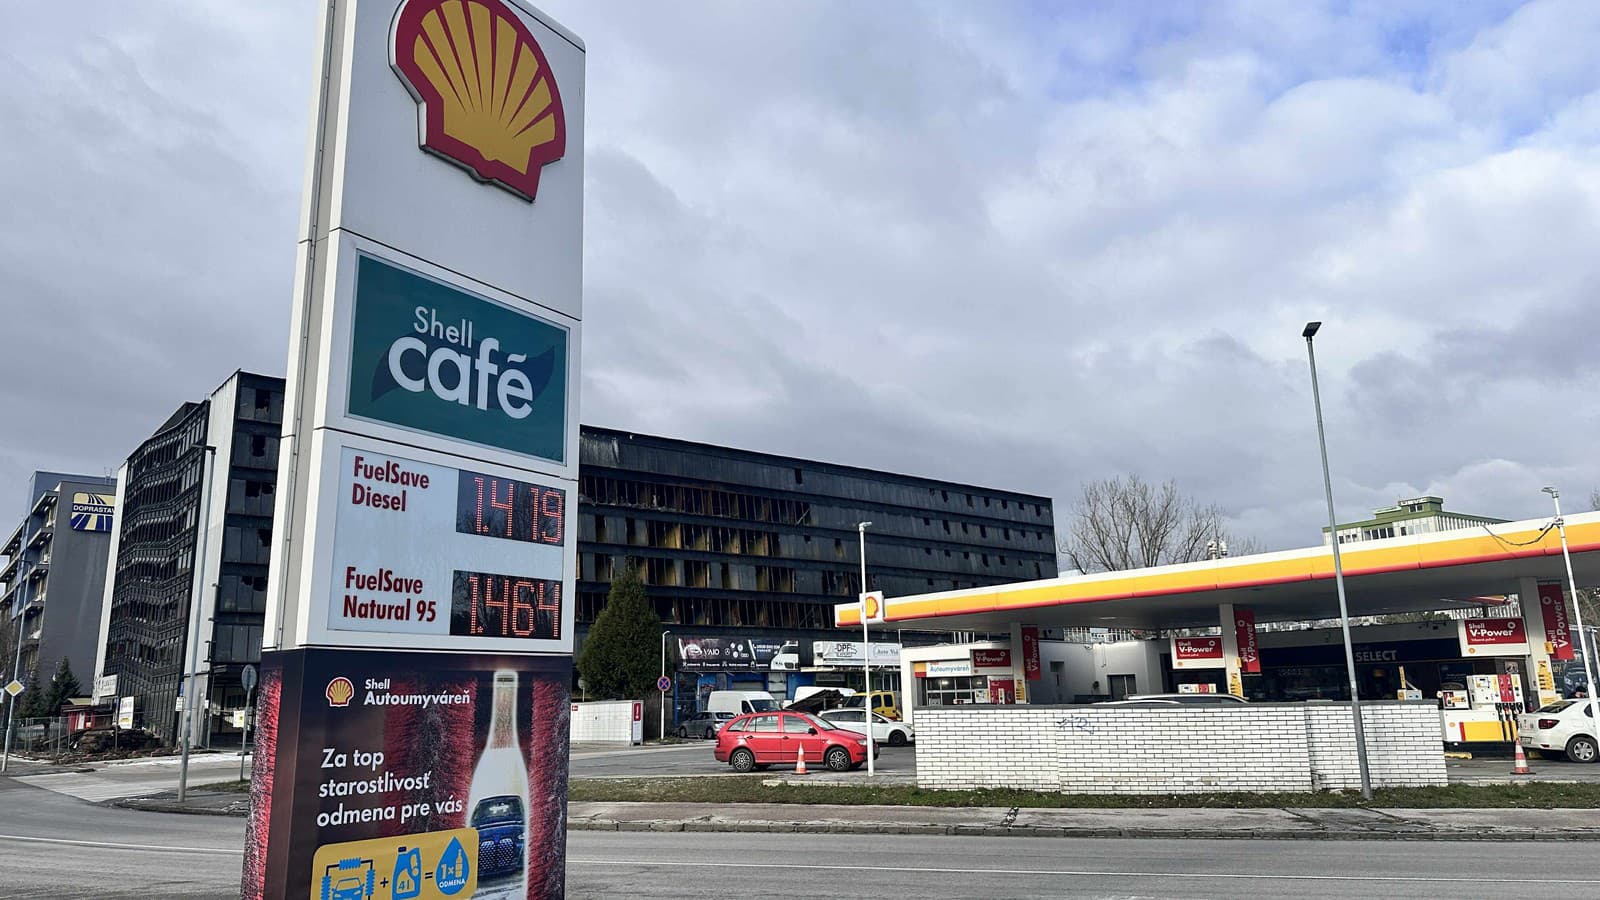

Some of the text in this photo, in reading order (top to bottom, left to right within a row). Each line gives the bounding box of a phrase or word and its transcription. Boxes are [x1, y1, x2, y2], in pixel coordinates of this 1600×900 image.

[413, 306, 473, 349] Shell
[388, 336, 533, 419] café
[353, 455, 430, 489] FuelSave
[352, 483, 407, 512] Diesel
[474, 476, 563, 543] 1.419
[345, 566, 424, 595] FuelSave
[343, 595, 437, 623] Natural 95
[469, 576, 561, 638] 1.464
[1470, 629, 1514, 637] V-Power
[1554, 600, 1569, 648] V-Power
[1247, 623, 1257, 662] V-Power
[1355, 650, 1397, 662] SELECT
[365, 678, 390, 690] Shell
[363, 690, 470, 709] Autoumyváreň
[321, 748, 385, 771] Za top
[319, 771, 432, 798] starostlivosť
[317, 795, 463, 828] odmena pre vás
[439, 878, 466, 889] ODMENA
